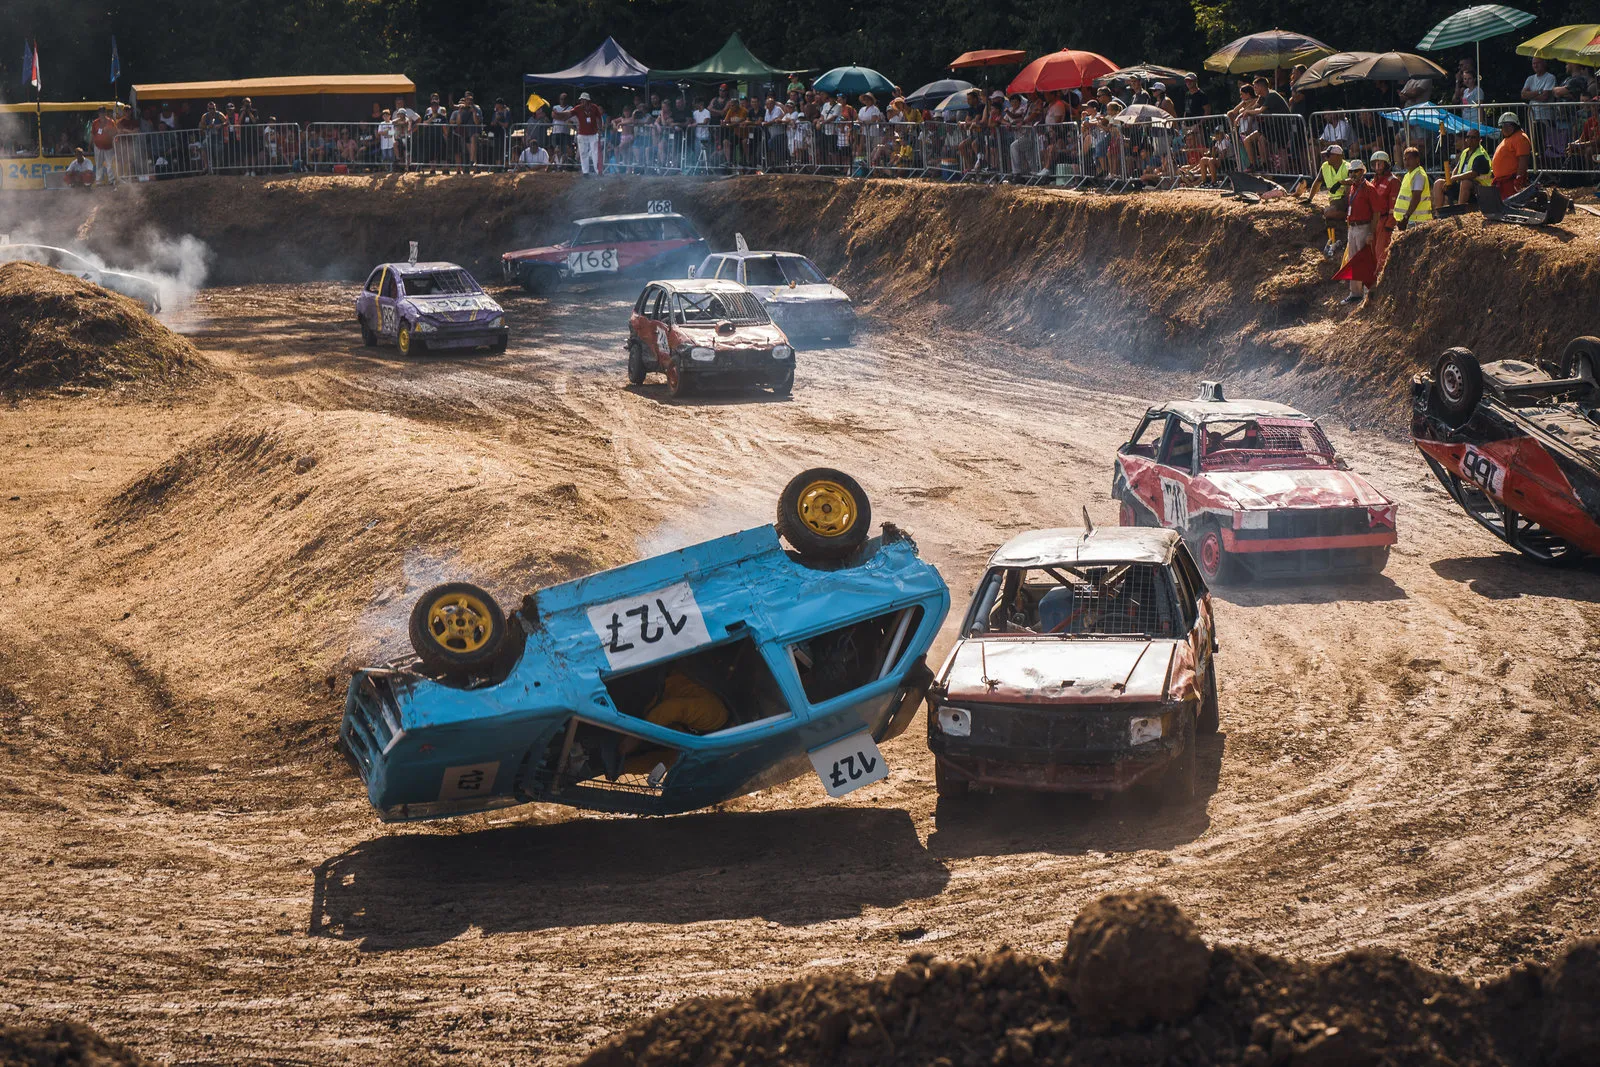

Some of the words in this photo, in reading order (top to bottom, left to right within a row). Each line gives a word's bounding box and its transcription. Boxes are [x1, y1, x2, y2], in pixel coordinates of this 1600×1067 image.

[648, 200, 671, 213] 168
[572, 250, 613, 271] 168
[606, 598, 687, 653] 127
[829, 751, 877, 788] 127
